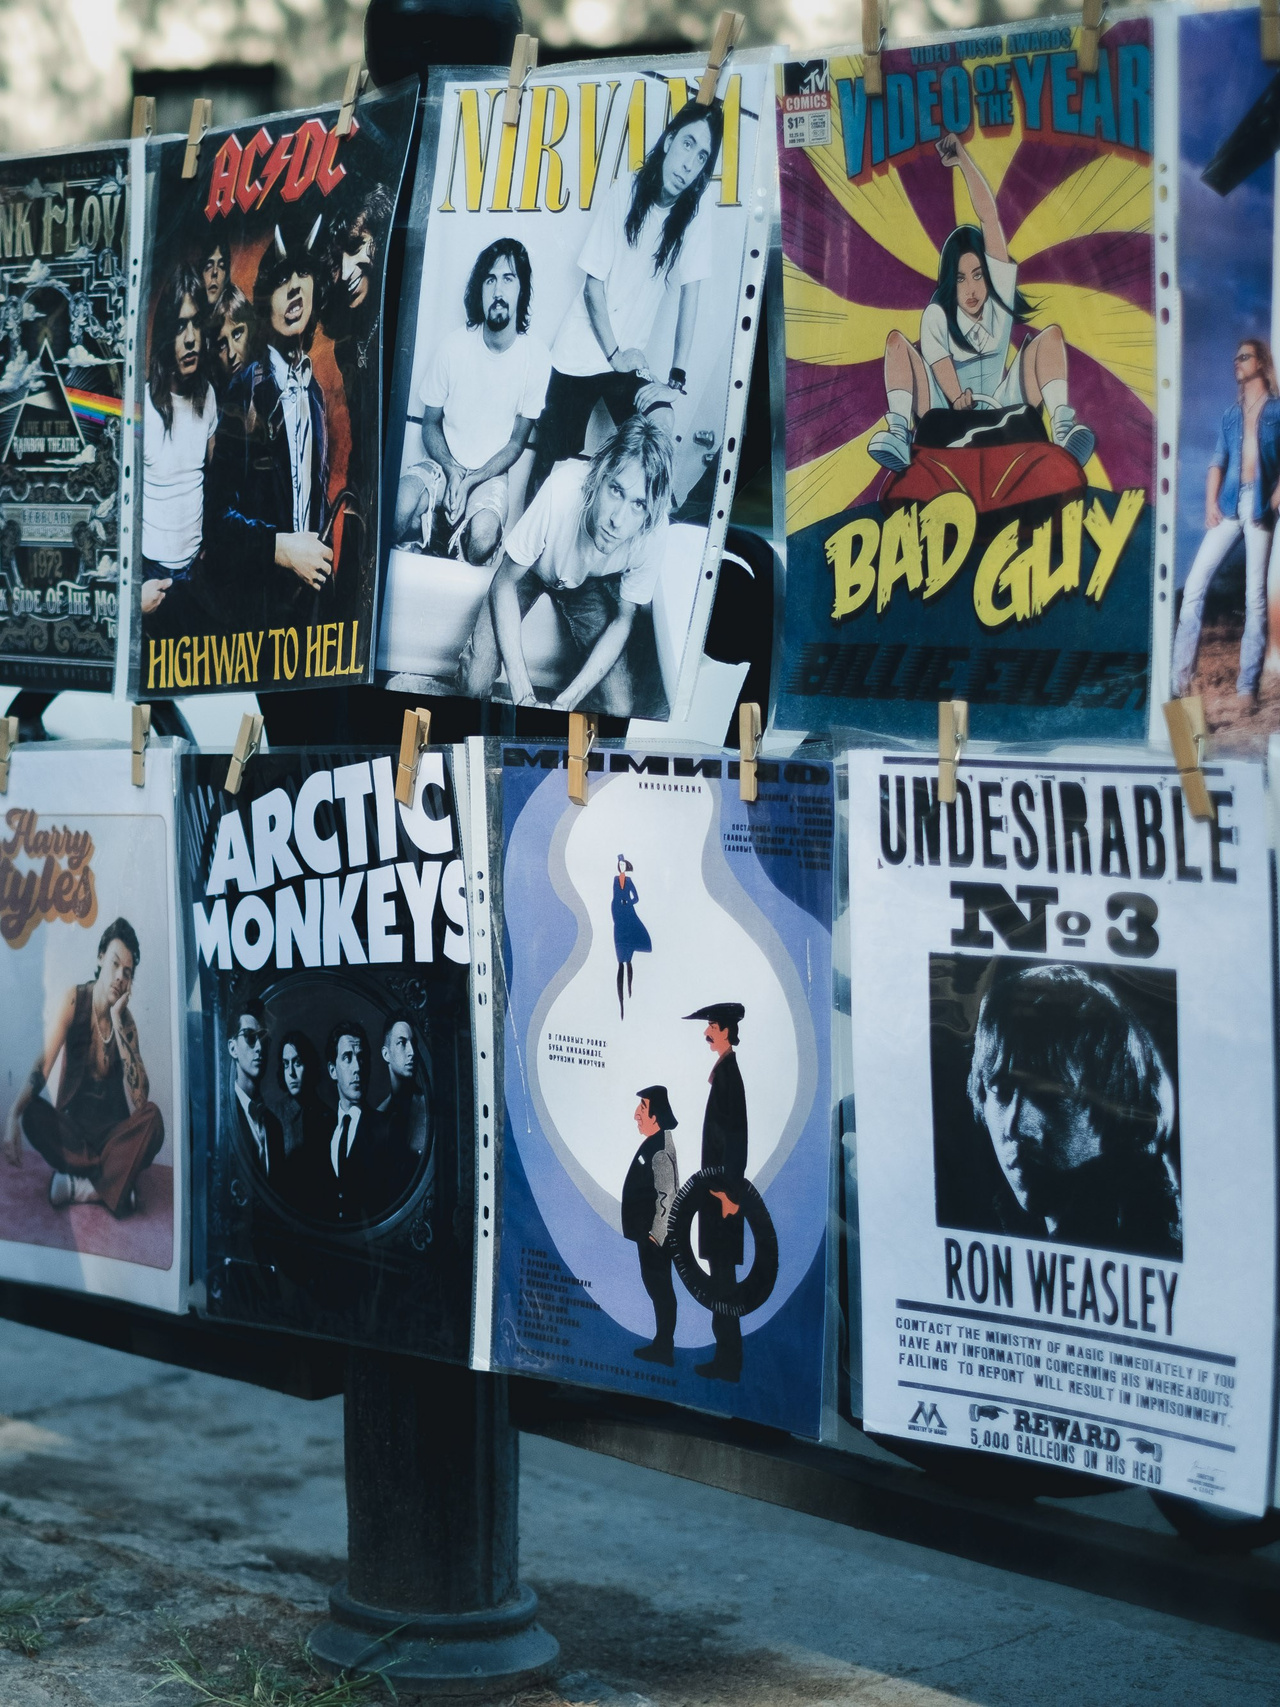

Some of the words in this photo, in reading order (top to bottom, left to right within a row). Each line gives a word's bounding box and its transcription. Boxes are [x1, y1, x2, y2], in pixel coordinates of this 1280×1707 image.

[910, 46, 950, 65] VIDEO
[955, 38, 1003, 60] MUSIC
[1006, 28, 1071, 55] AWARDS
[786, 94, 828, 111] COMICS
[974, 64, 1012, 95] OF
[976, 93, 1014, 128] THE
[1013, 43, 1152, 152] YEAR
[836, 64, 972, 180] VIDEO
[40, 190, 129, 255] FLOY
[47, 437, 81, 453] THEATRE
[32, 551, 63, 578] 1972
[825, 491, 977, 619] BAD
[973, 489, 1145, 627] GUY
[12, 586, 42, 616] SIDE
[57, 580, 91, 615] THE
[147, 630, 264, 689] HIGHWAY
[268, 627, 299, 681] TO
[304, 620, 364, 676] HELL
[3, 808, 94, 872] Harry
[206, 752, 453, 896] ARCTIC
[879, 774, 1238, 884] UNDESIRABLE
[193, 859, 470, 971] MONKEYS
[1106, 891, 1160, 959] 3
[944, 1237, 1014, 1308] RON
[1026, 1248, 1178, 1336] WEASLEY
[895, 1317, 952, 1336] CONTACT
[957, 1326, 980, 1341] THE
[985, 1331, 1042, 1350] MINISTRY
[1047, 1341, 1060, 1354] OF
[1066, 1344, 1104, 1362] MAGIC
[1109, 1351, 1194, 1380] IMMEDIATELY
[1198, 1369, 1209, 1383] IF
[1214, 1373, 1235, 1389] YOU
[899, 1334, 930, 1351] HAVE
[935, 1340, 958, 1355] ANY
[962, 1343, 1041, 1369] INFORMATION
[1046, 1358, 1116, 1383] CONCERNING
[1121, 1373, 1140, 1389] HIS
[899, 1352, 948, 1372] FAILING
[958, 1361, 974, 1376] TO
[978, 1365, 1024, 1384] REPORT
[1034, 1374, 1063, 1391] WILL
[1068, 1380, 1114, 1401] RESULT
[1119, 1390, 1131, 1405] IN
[970, 1428, 1010, 1451] 5,000
[1016, 1434, 1076, 1465] GALLEONS
[1083, 1449, 1098, 1470] ON
[1106, 1454, 1126, 1476] HIS
[1132, 1460, 1162, 1485] HEAD
[1013, 1408, 1120, 1452] REWARD
